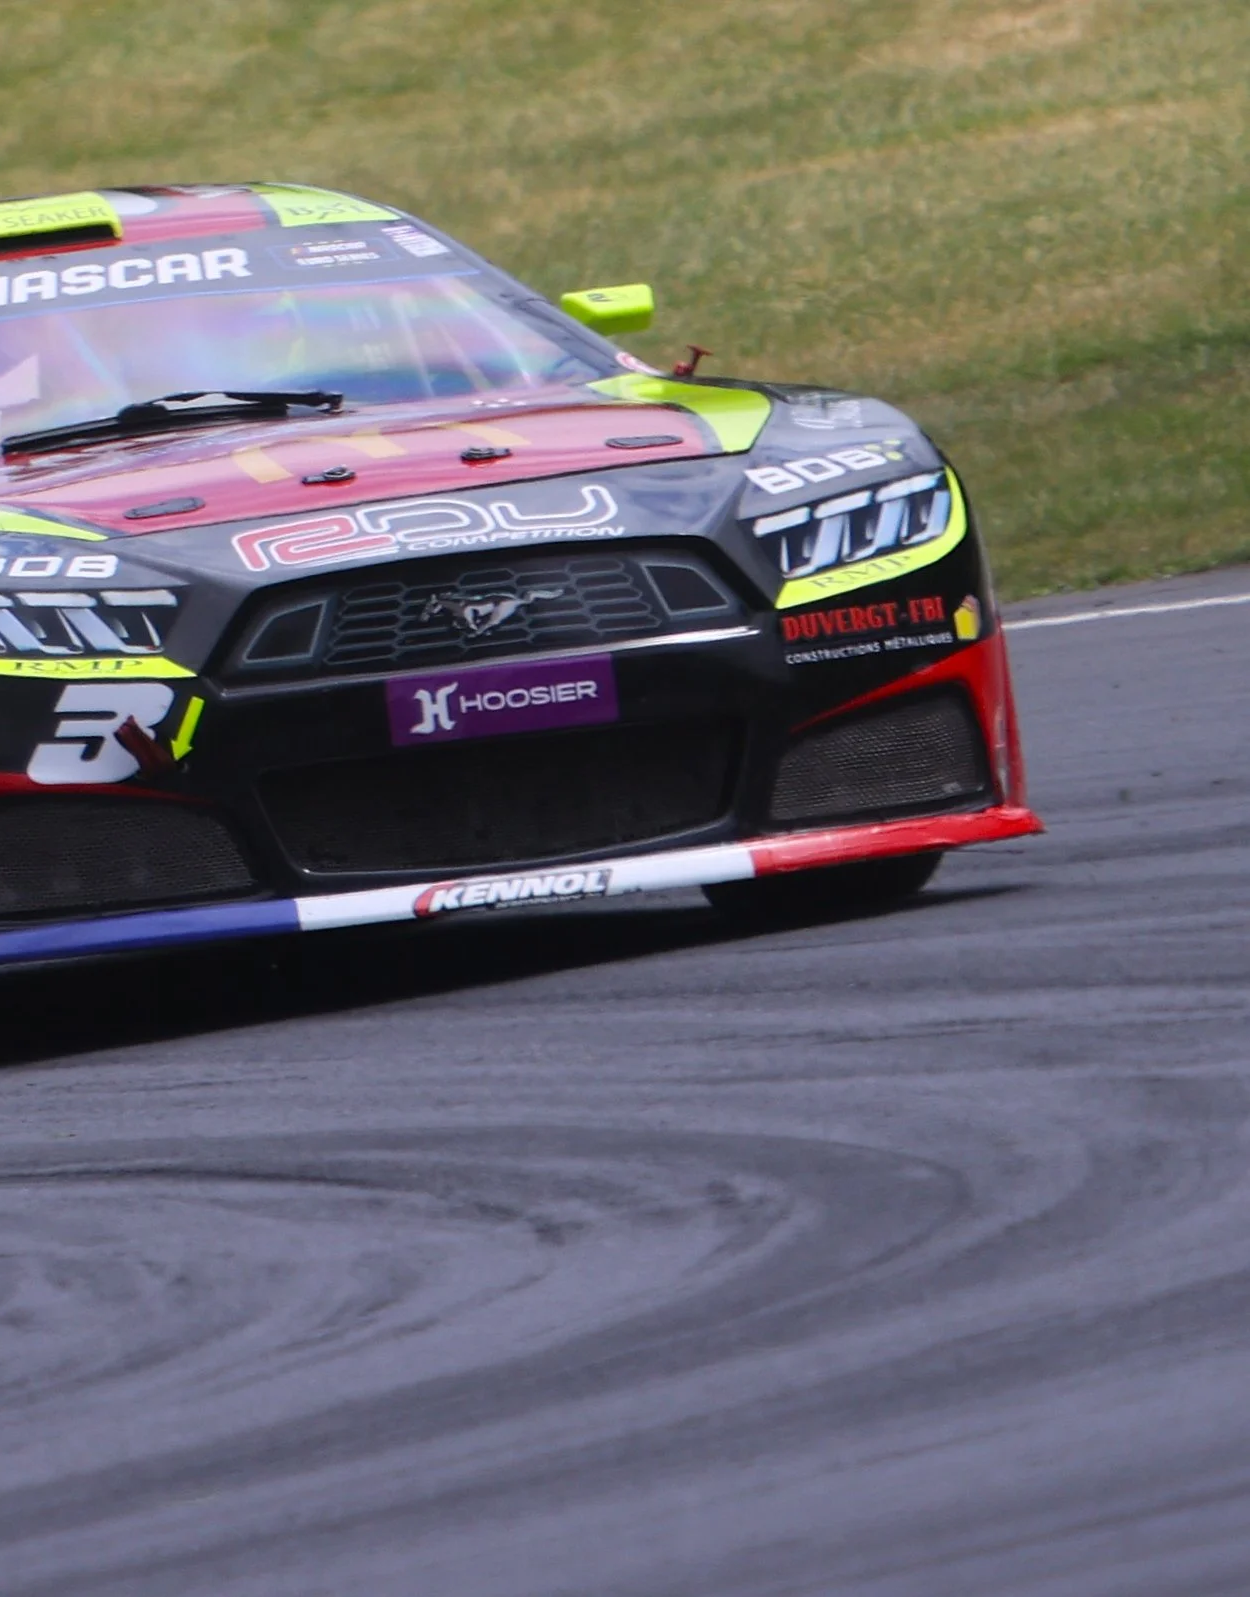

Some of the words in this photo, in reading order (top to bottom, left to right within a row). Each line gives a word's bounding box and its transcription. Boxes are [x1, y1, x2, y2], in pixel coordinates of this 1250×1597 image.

[406, 525, 626, 552] COMPETITION
[13, 660, 143, 673] RMP
[785, 642, 881, 665] CONSTRUCTIONS
[459, 680, 598, 713] HOOSIER
[26, 682, 175, 785] 3
[428, 870, 606, 913] KENNOL
